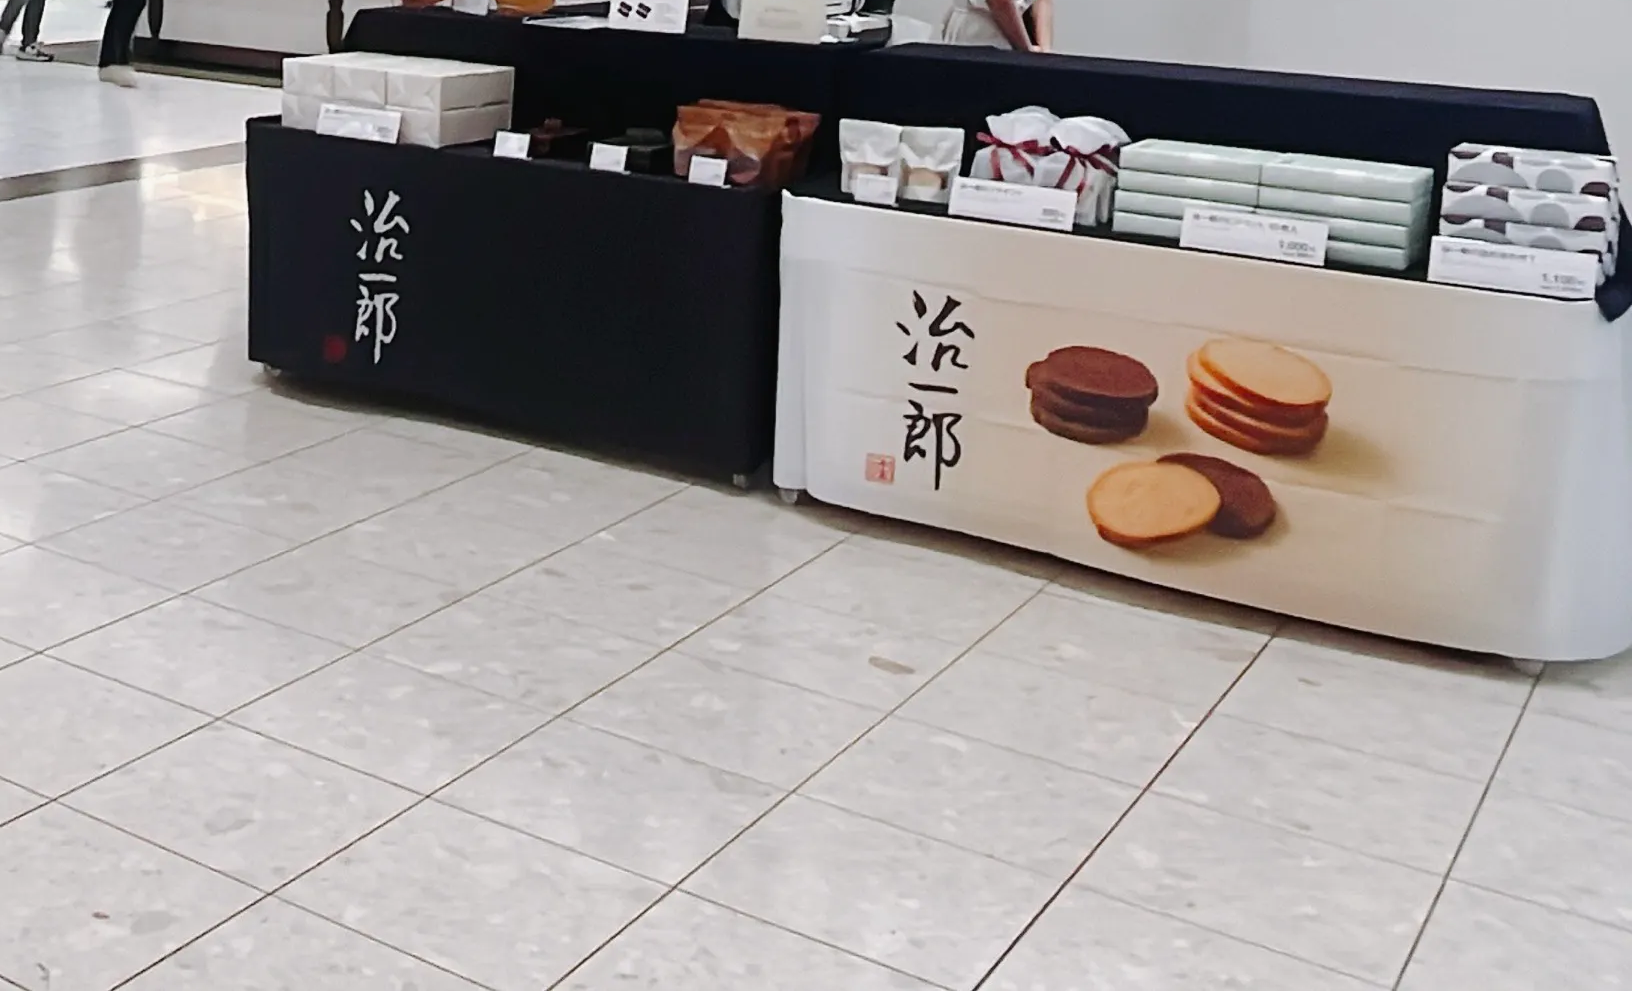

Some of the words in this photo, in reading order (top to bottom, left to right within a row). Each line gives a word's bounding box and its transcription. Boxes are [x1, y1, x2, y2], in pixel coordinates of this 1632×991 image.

[350, 189, 410, 364] 治一郎
[895, 289, 975, 491] 治一郎
